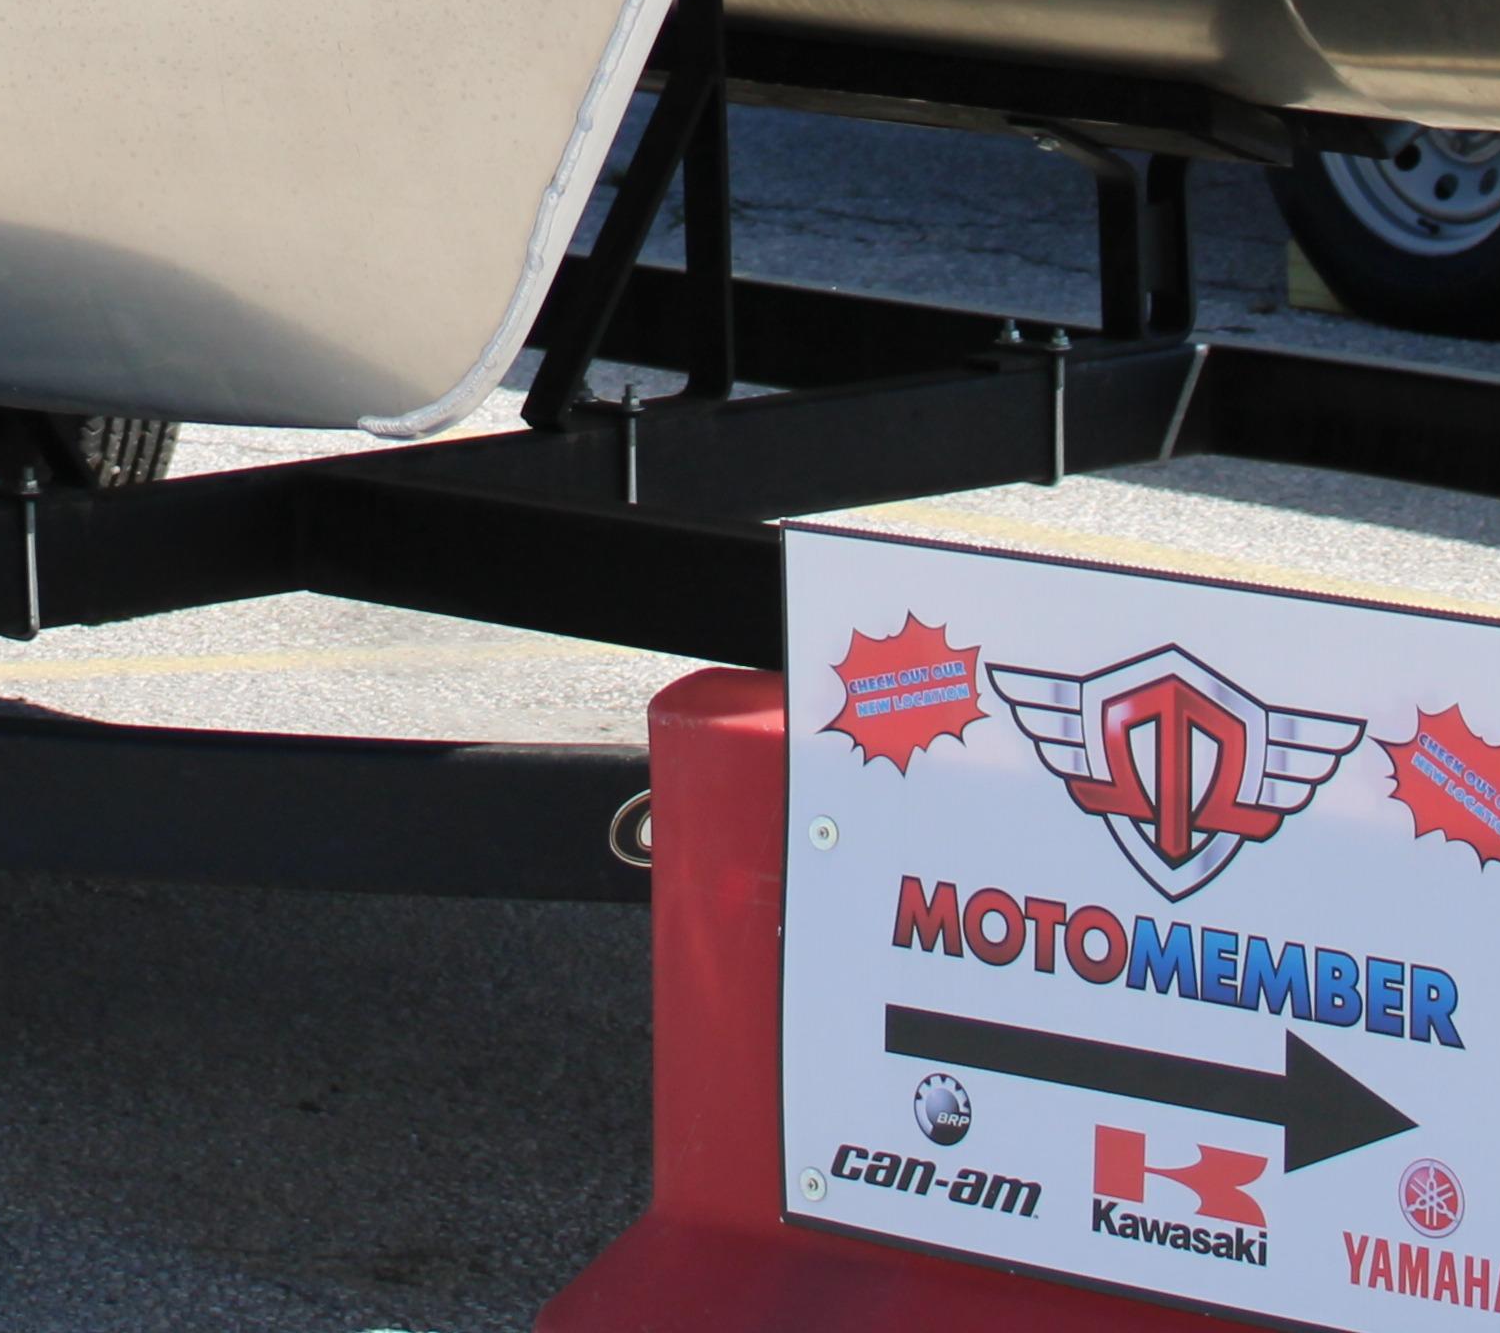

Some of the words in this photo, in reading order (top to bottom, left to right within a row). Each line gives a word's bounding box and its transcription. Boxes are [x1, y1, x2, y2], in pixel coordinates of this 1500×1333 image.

[848, 672, 897, 694] CHECK
[898, 666, 930, 685] OUT
[932, 660, 966, 679] OUR
[855, 697, 891, 718] NEW
[893, 683, 970, 711] LOCATION
[1411, 751, 1448, 787] NEW
[1418, 732, 1465, 778] CHECK
[1464, 770, 1497, 801] OUT
[892, 875, 1465, 1049] MOTOMEMBER
[936, 1111, 970, 1127] BRP
[830, 1144, 1042, 1218] can-am
[1092, 1198, 1267, 1267] Kawasaki
